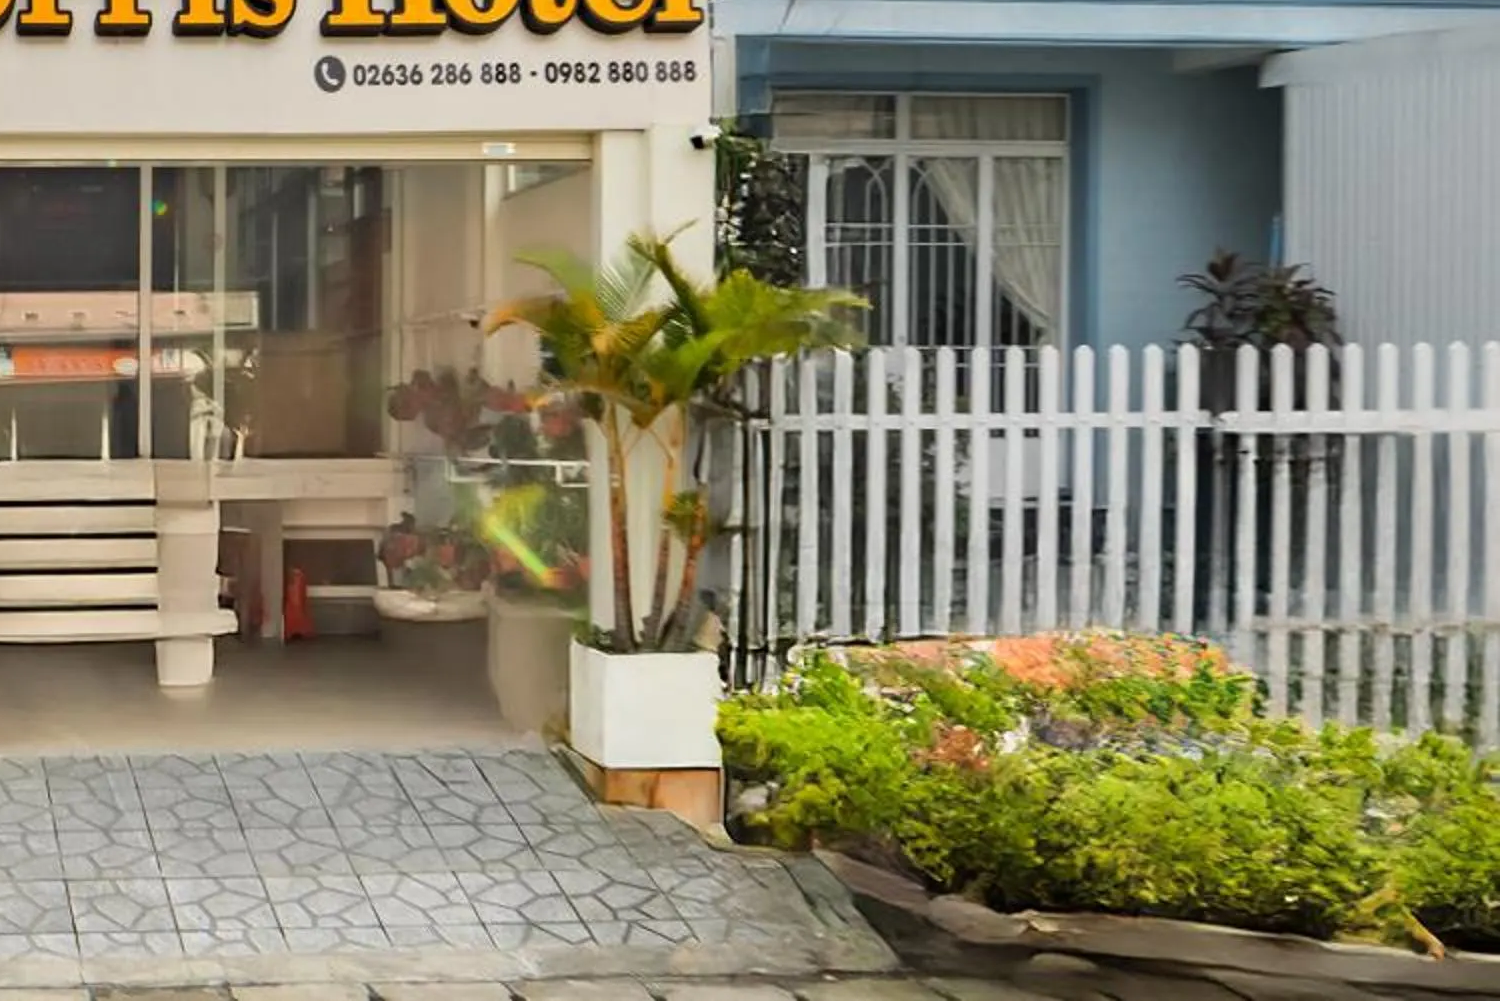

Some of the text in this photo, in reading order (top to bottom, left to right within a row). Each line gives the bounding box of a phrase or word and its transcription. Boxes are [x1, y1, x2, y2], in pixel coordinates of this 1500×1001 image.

[353, 64, 423, 86] 02636
[430, 63, 473, 85] 286
[480, 62, 521, 84] 888
[544, 61, 601, 84] 0982
[608, 61, 649, 83] 880
[655, 60, 696, 83] 888
